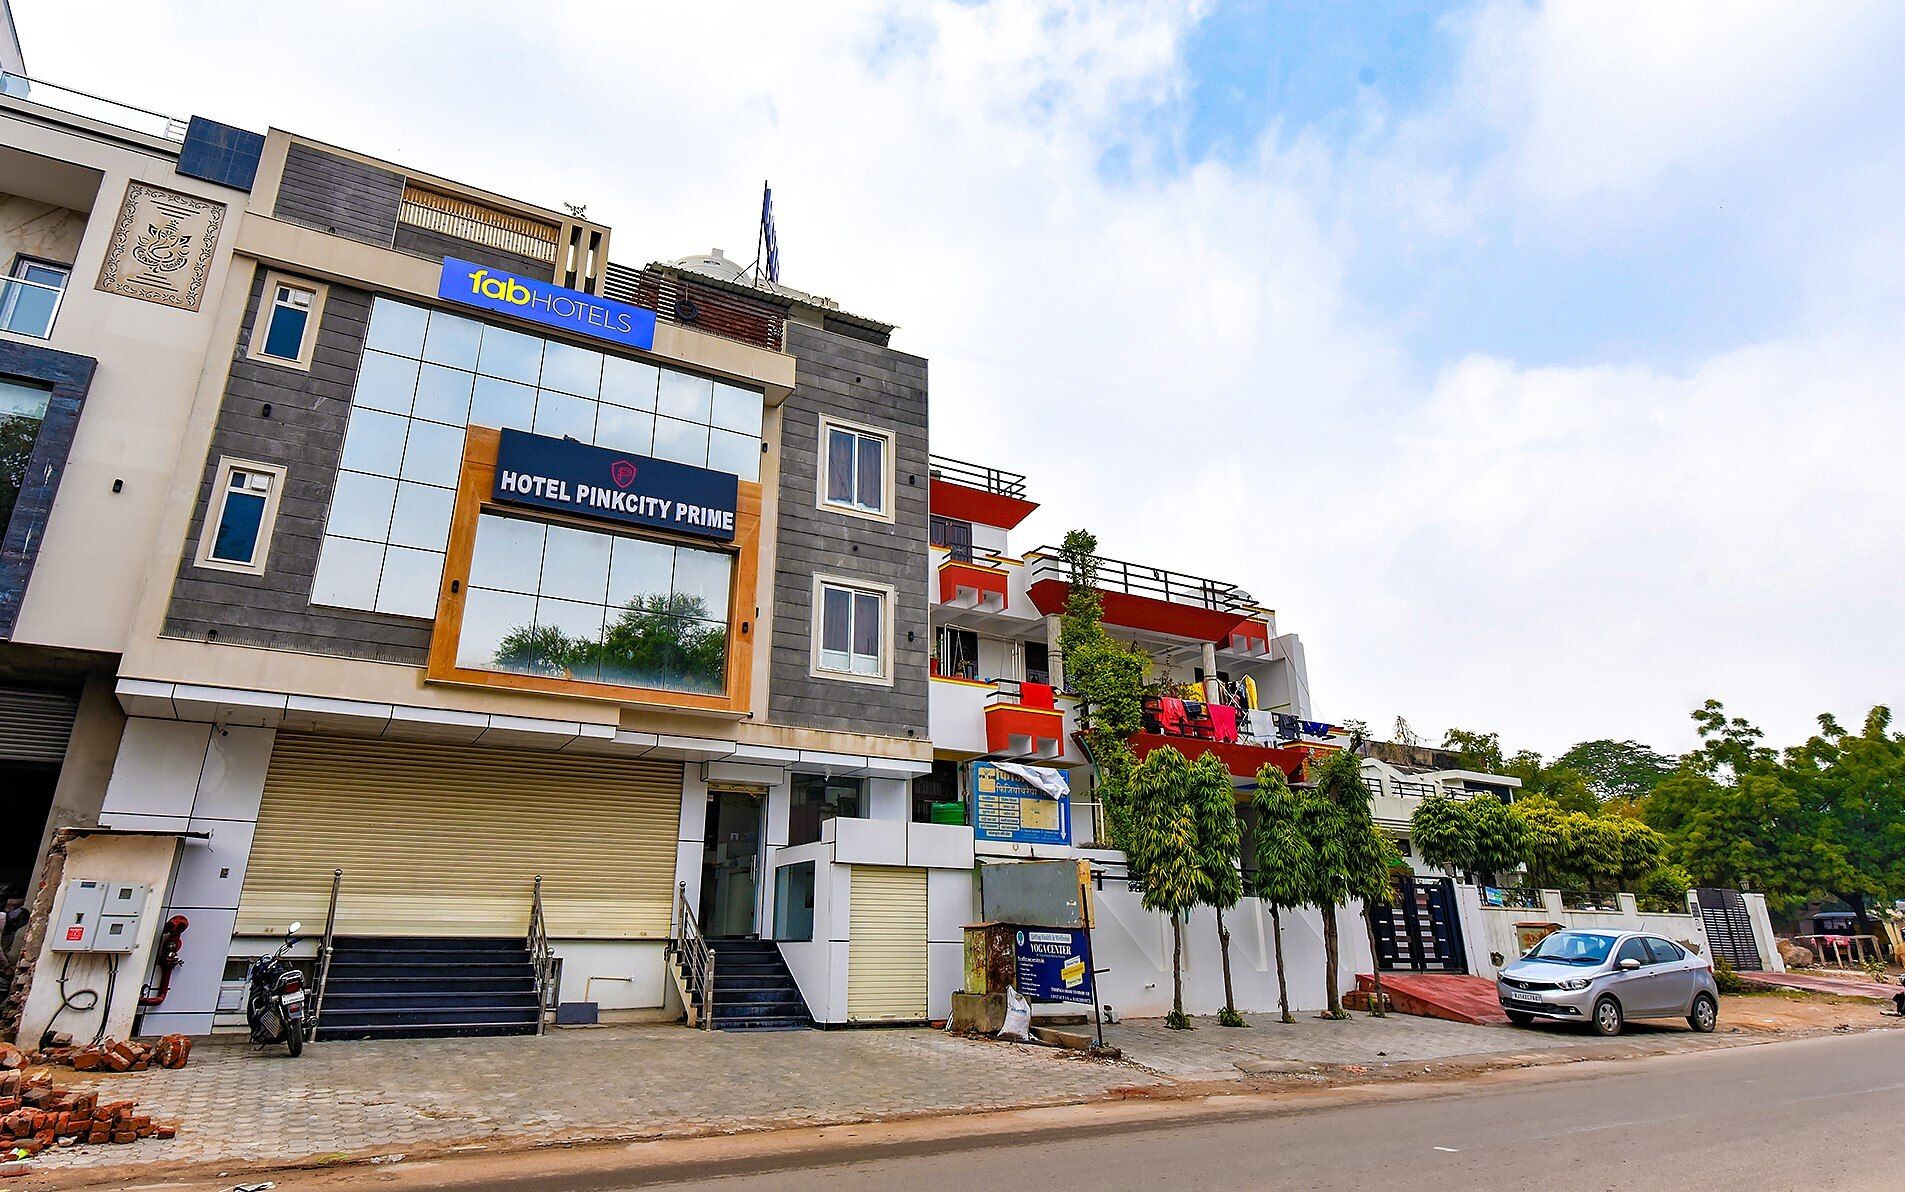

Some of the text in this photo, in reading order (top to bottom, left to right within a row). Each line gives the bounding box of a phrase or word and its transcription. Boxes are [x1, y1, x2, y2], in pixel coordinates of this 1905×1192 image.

[500, 470, 734, 531] HOTEL PINKCITY PRIME
